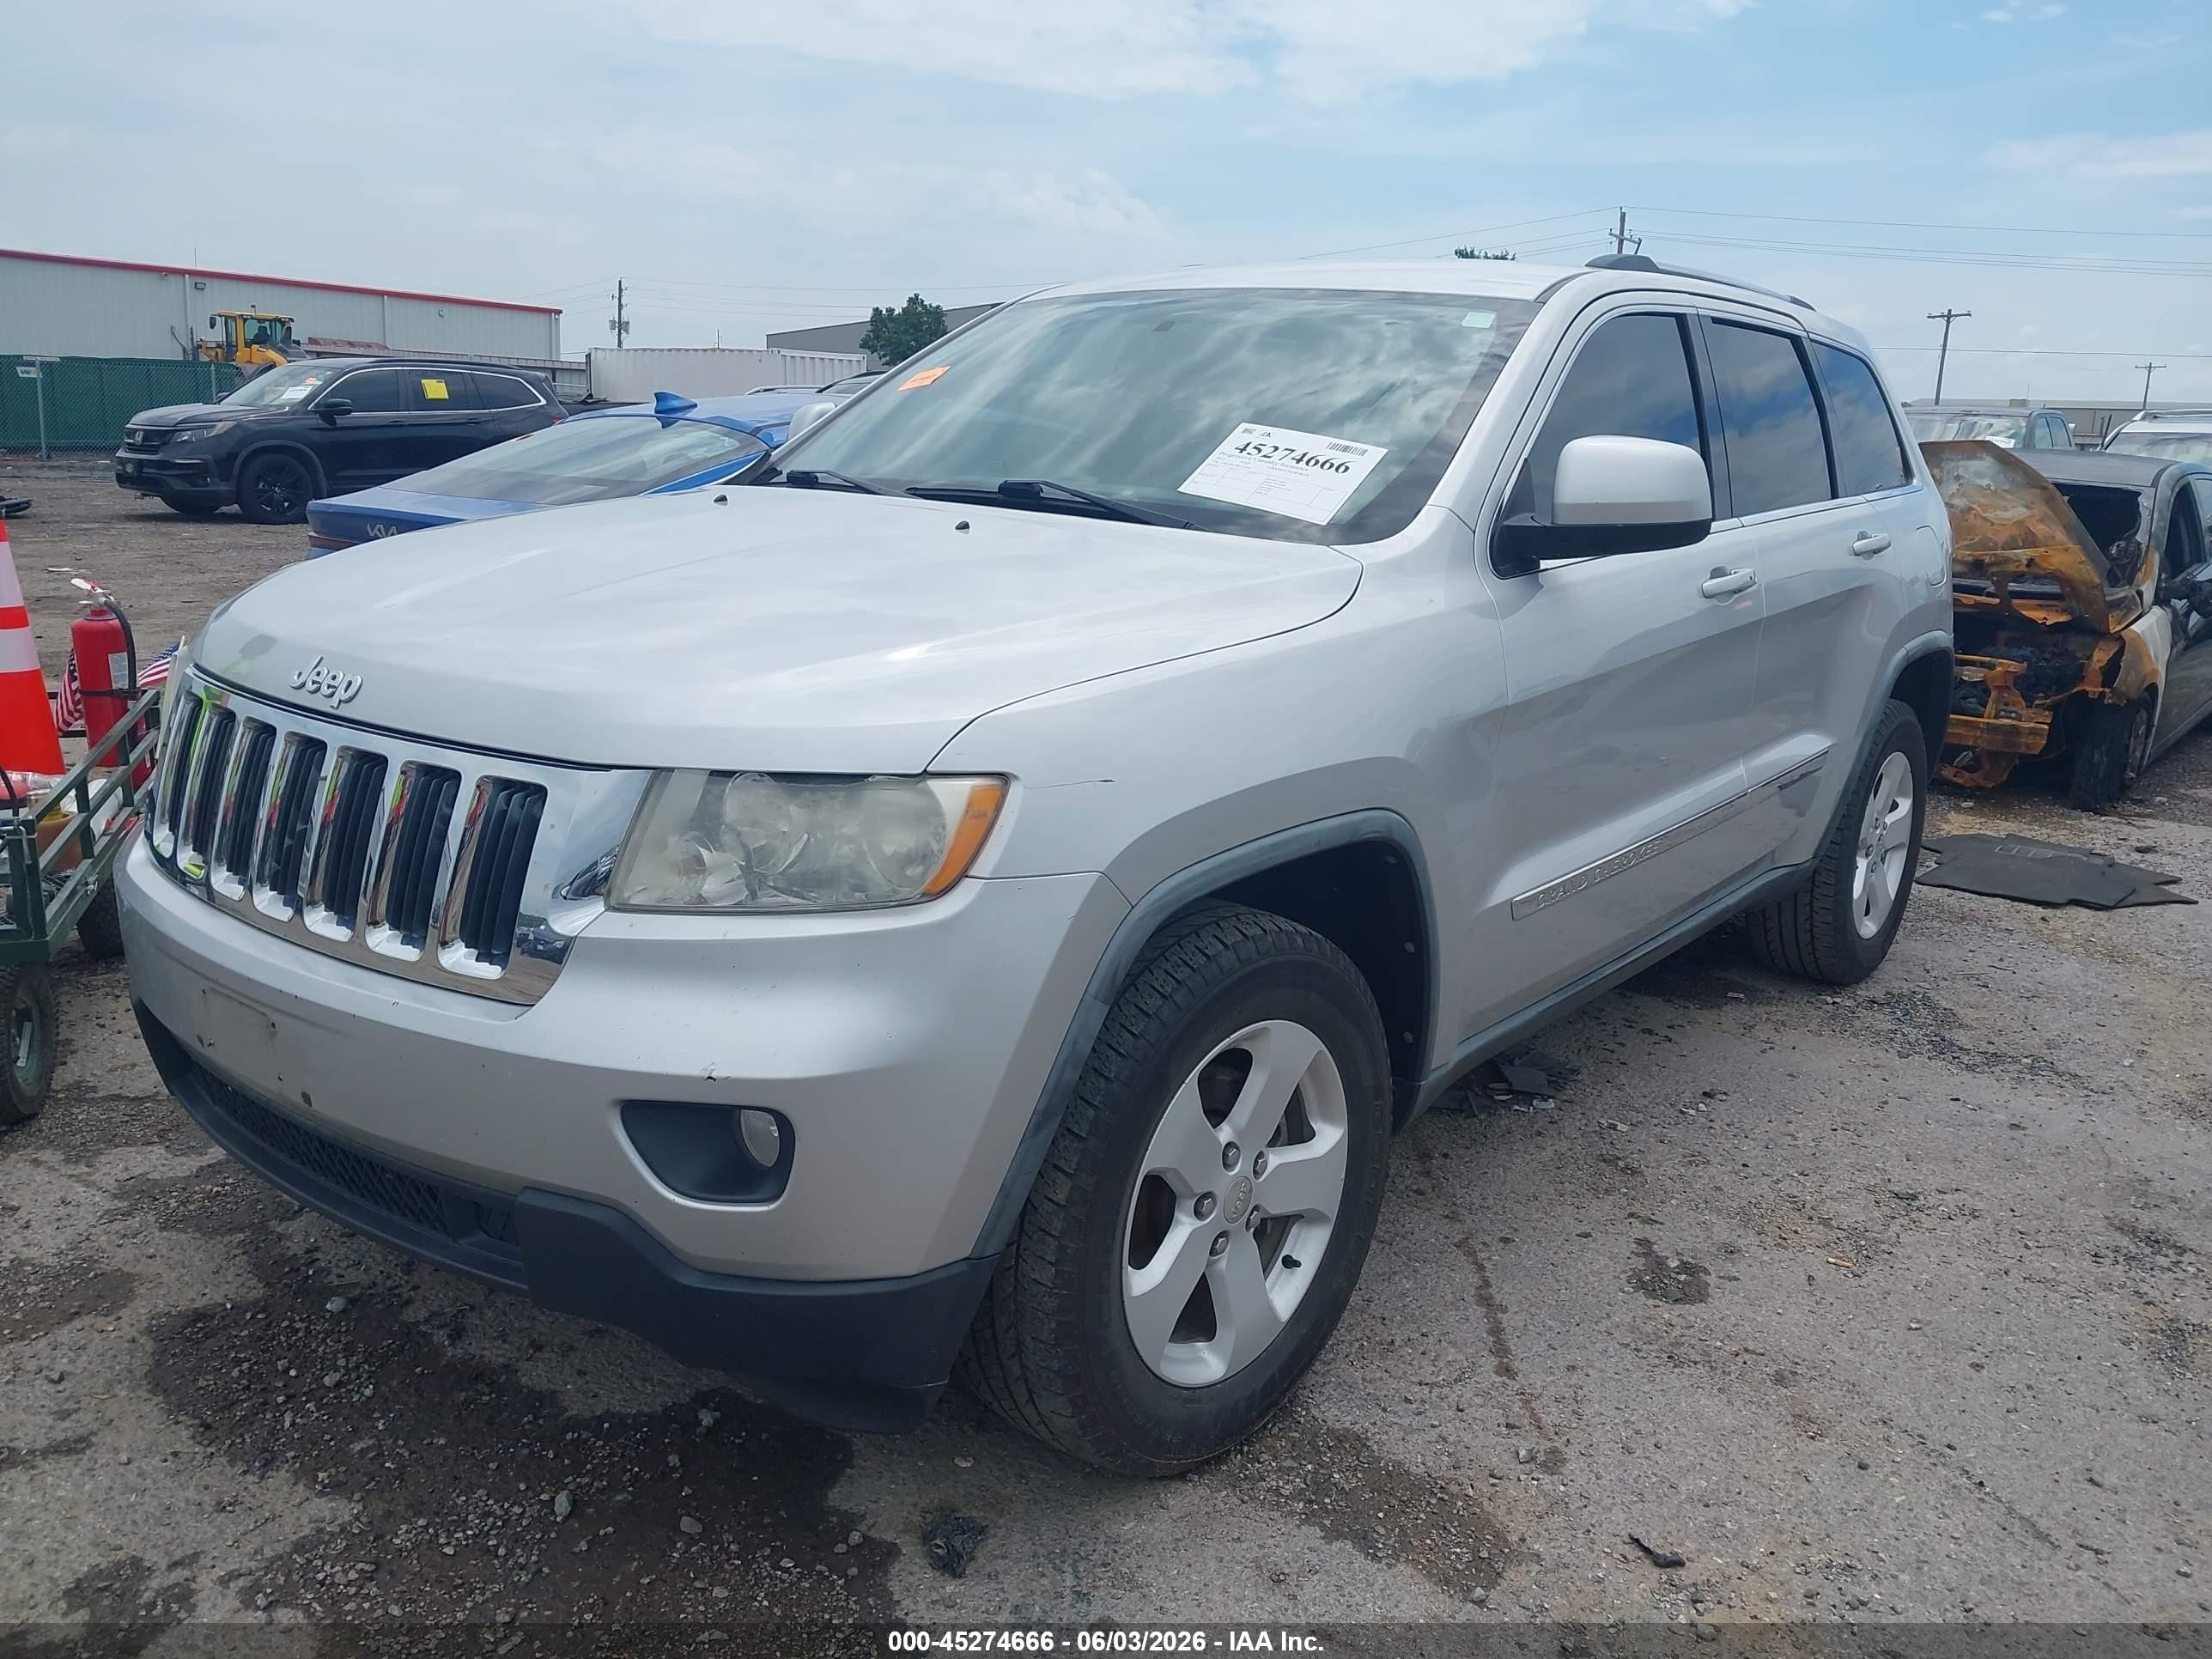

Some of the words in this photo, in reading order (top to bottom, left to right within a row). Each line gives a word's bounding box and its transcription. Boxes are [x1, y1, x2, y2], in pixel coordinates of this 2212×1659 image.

[1234, 441, 1355, 475] 45274666
[367, 523, 398, 538] KIA
[289, 655, 363, 709] Jeep
